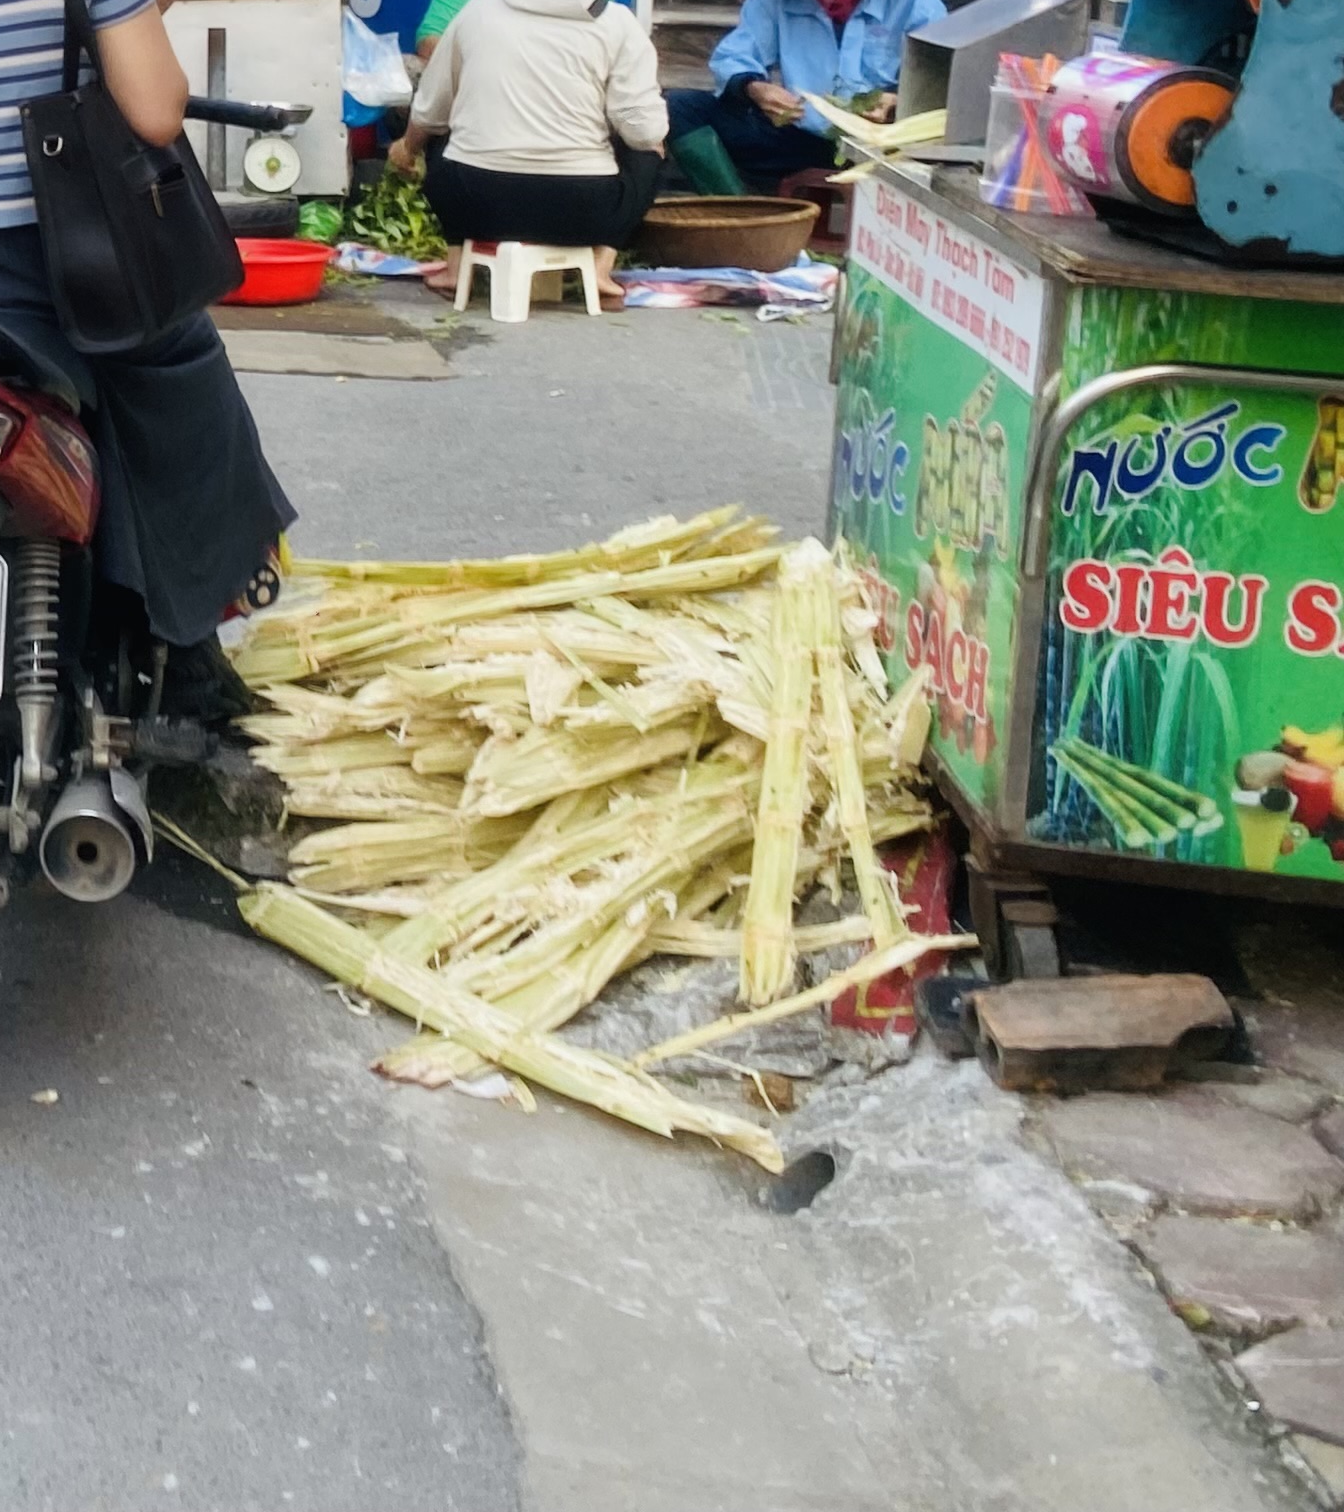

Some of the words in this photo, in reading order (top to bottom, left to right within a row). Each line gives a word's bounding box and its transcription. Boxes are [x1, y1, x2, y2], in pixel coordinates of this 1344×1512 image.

[1060, 399, 1287, 517] NƯỚC
[1059, 544, 1271, 650] SIÊU
[1285, 579, 1344, 656] S
